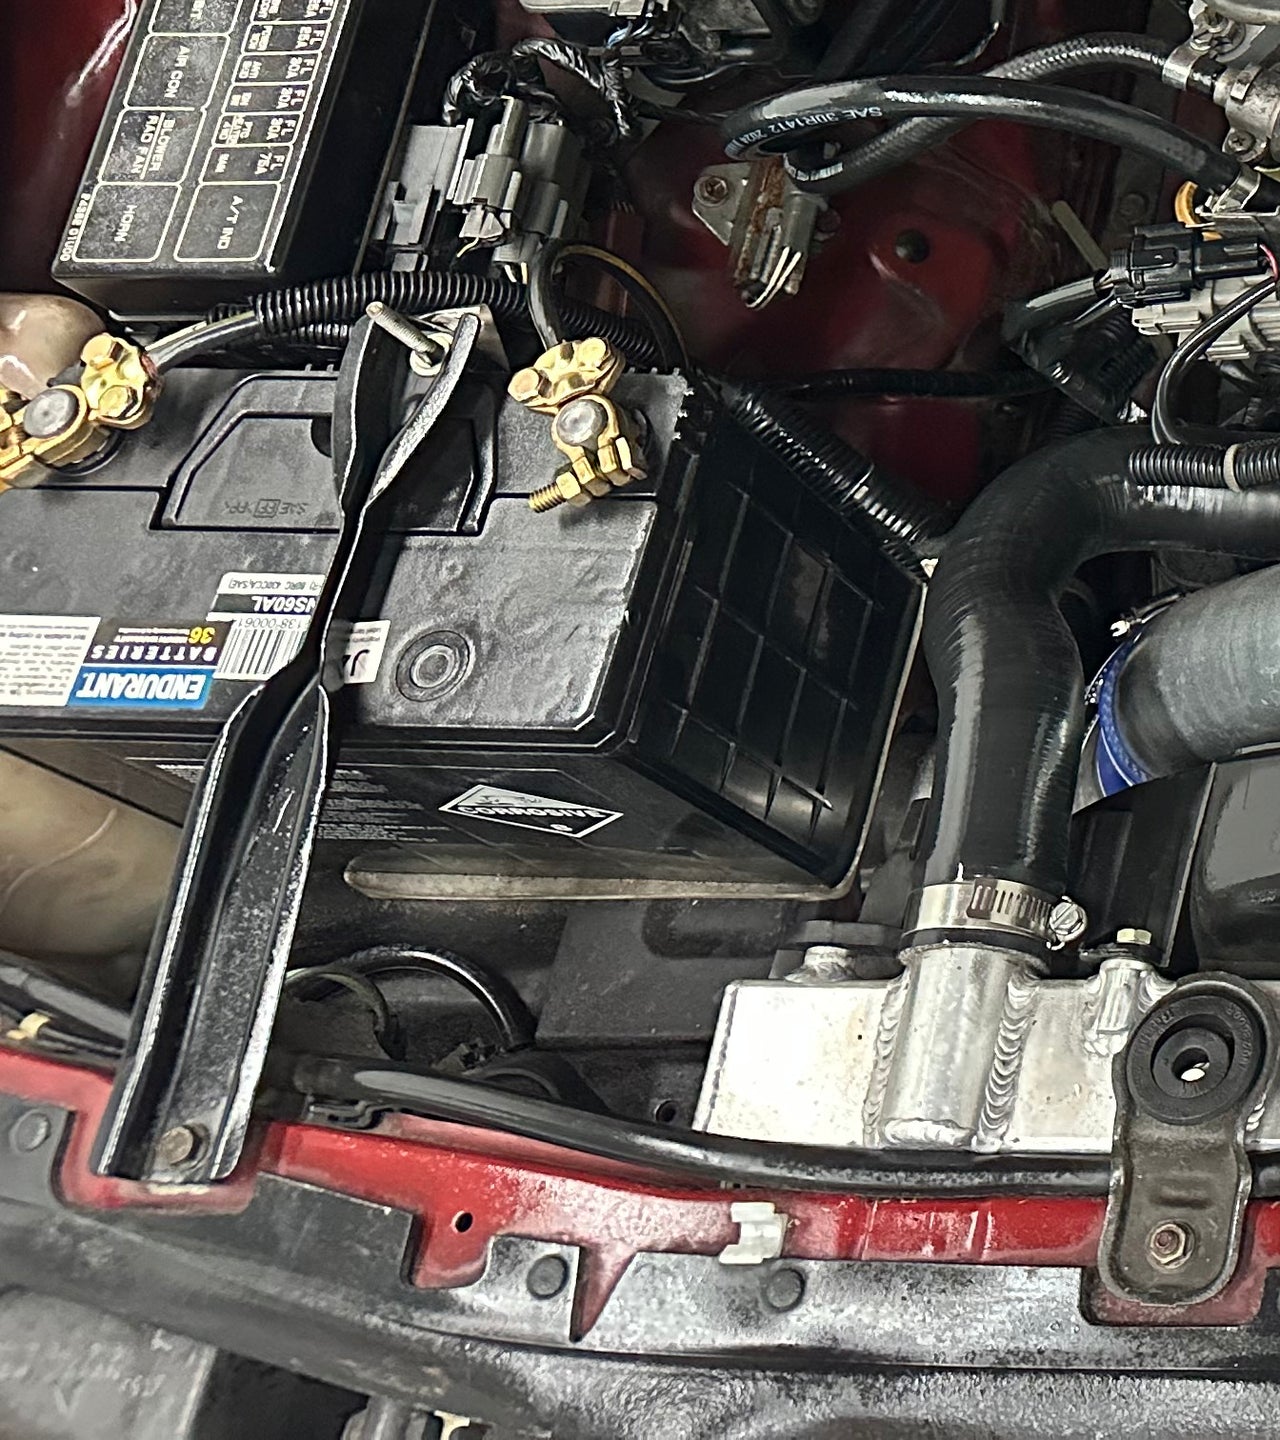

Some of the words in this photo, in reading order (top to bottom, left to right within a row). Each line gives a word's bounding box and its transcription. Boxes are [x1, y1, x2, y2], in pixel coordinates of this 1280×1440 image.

[318, 0, 333, 13] FL
[308, 29, 324, 44] FL
[173, 45, 191, 68] AIR
[299, 59, 314, 74] FL
[163, 70, 183, 97] CON
[290, 89, 305, 104] FL
[842, 106, 883, 119] SAE
[139, 115, 159, 142] RAD
[280, 119, 296, 135] FL
[147, 119, 175, 171] BLOWER
[129, 146, 149, 173] FAN
[269, 154, 285, 169] FL
[224, 195, 244, 224] A/T
[113, 204, 138, 241] HORN
[215, 227, 234, 249] IND
[189, 626, 216, 644] 36
[91, 645, 218, 661] BATTERIES
[457, 805, 605, 820] CORROSIVE
